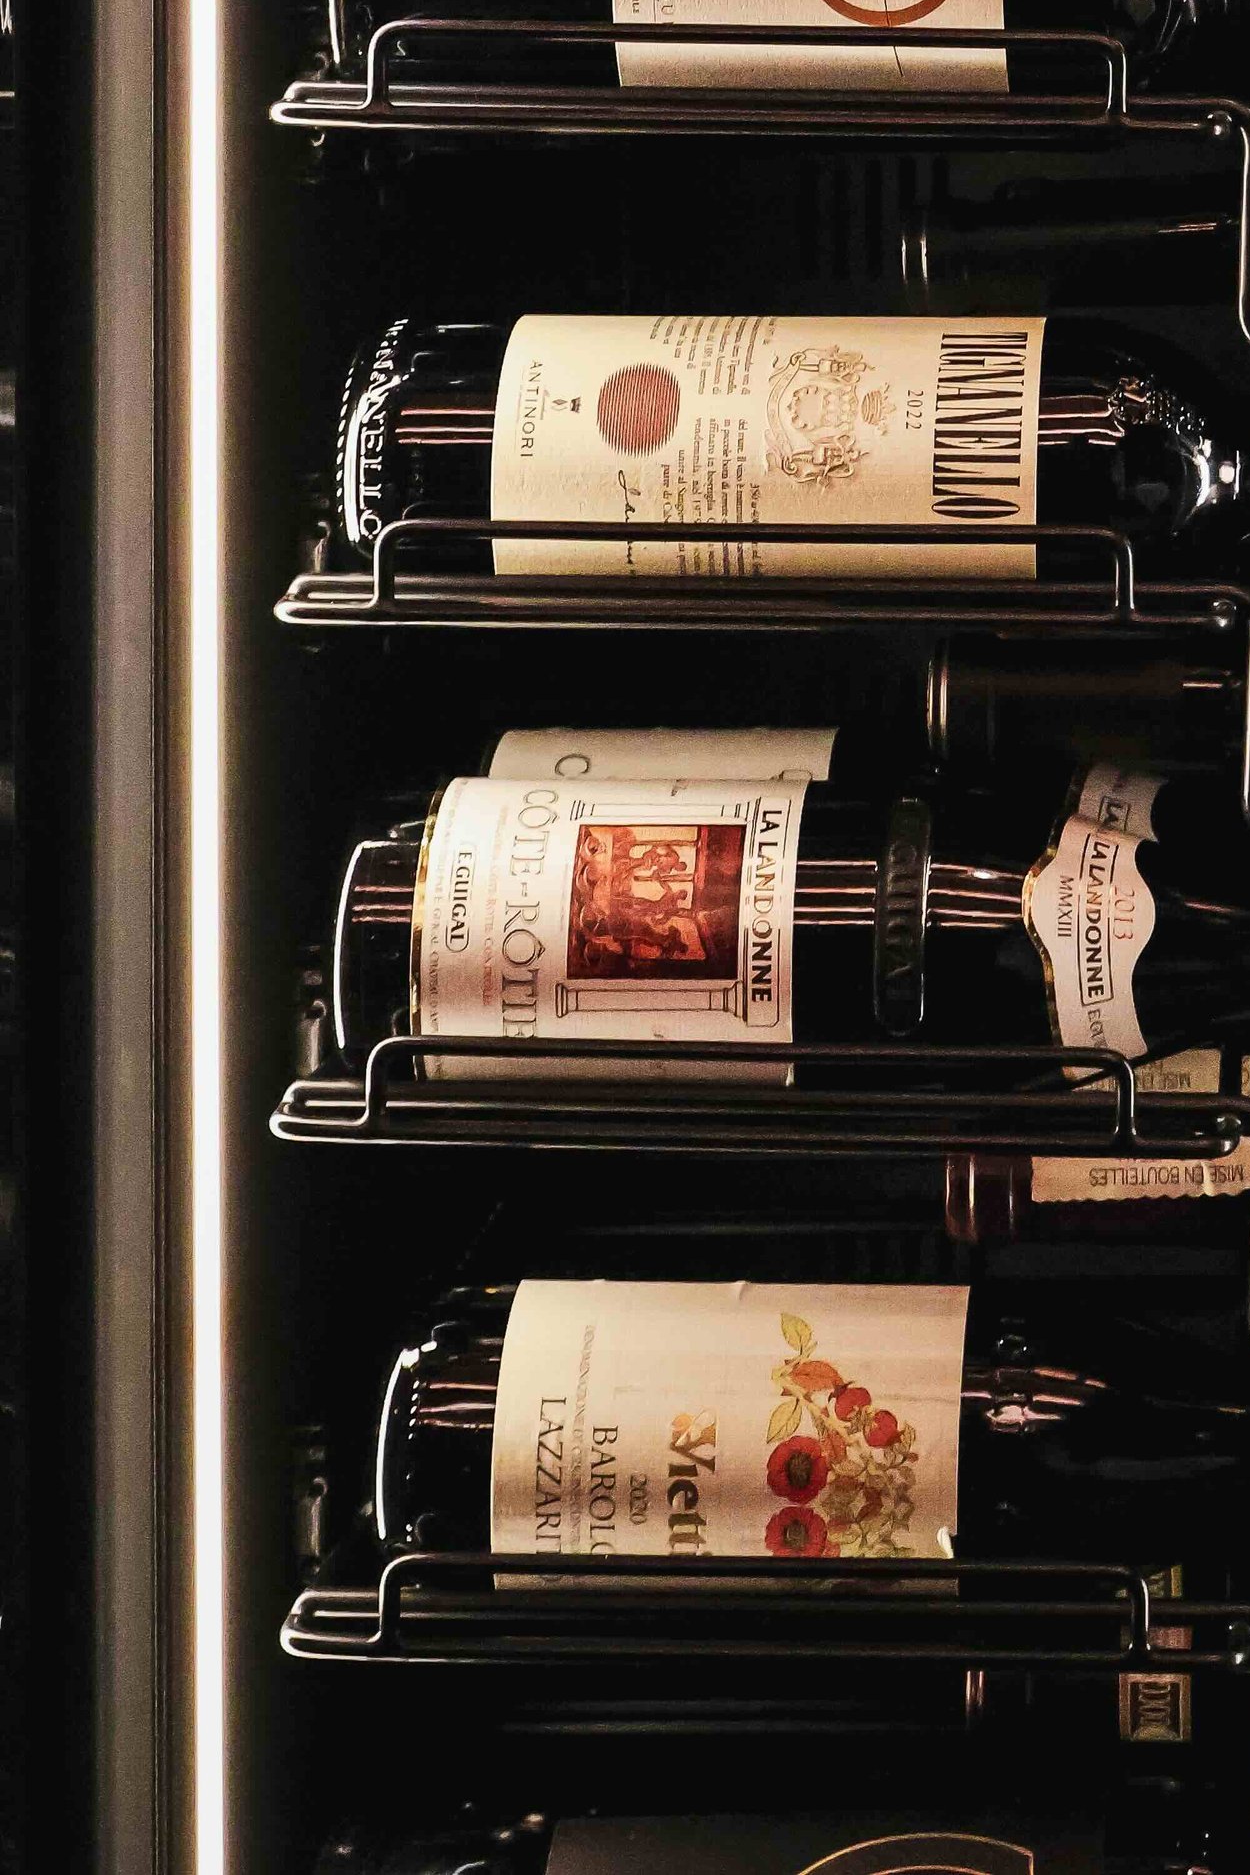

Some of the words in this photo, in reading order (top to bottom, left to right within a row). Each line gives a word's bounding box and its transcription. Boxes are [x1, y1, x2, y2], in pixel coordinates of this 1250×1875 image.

[520, 360, 543, 458] ANTINORI
[905, 389, 924, 431] 2022
[930, 331, 1028, 521] TIGNANELLO
[760, 809, 783, 834] LA
[1090, 841, 1111, 861] LA
[750, 841, 777, 1003] LANDONNE
[1056, 874, 1075, 940] MMXIII
[1084, 864, 1106, 1001] LANDONNE
[1113, 887, 1137, 941] 2013
[1088, 1166, 1182, 1187] BOUTEILLES
[1206, 1164, 1245, 1183] MISE
[628, 1473, 650, 1525] 2020
